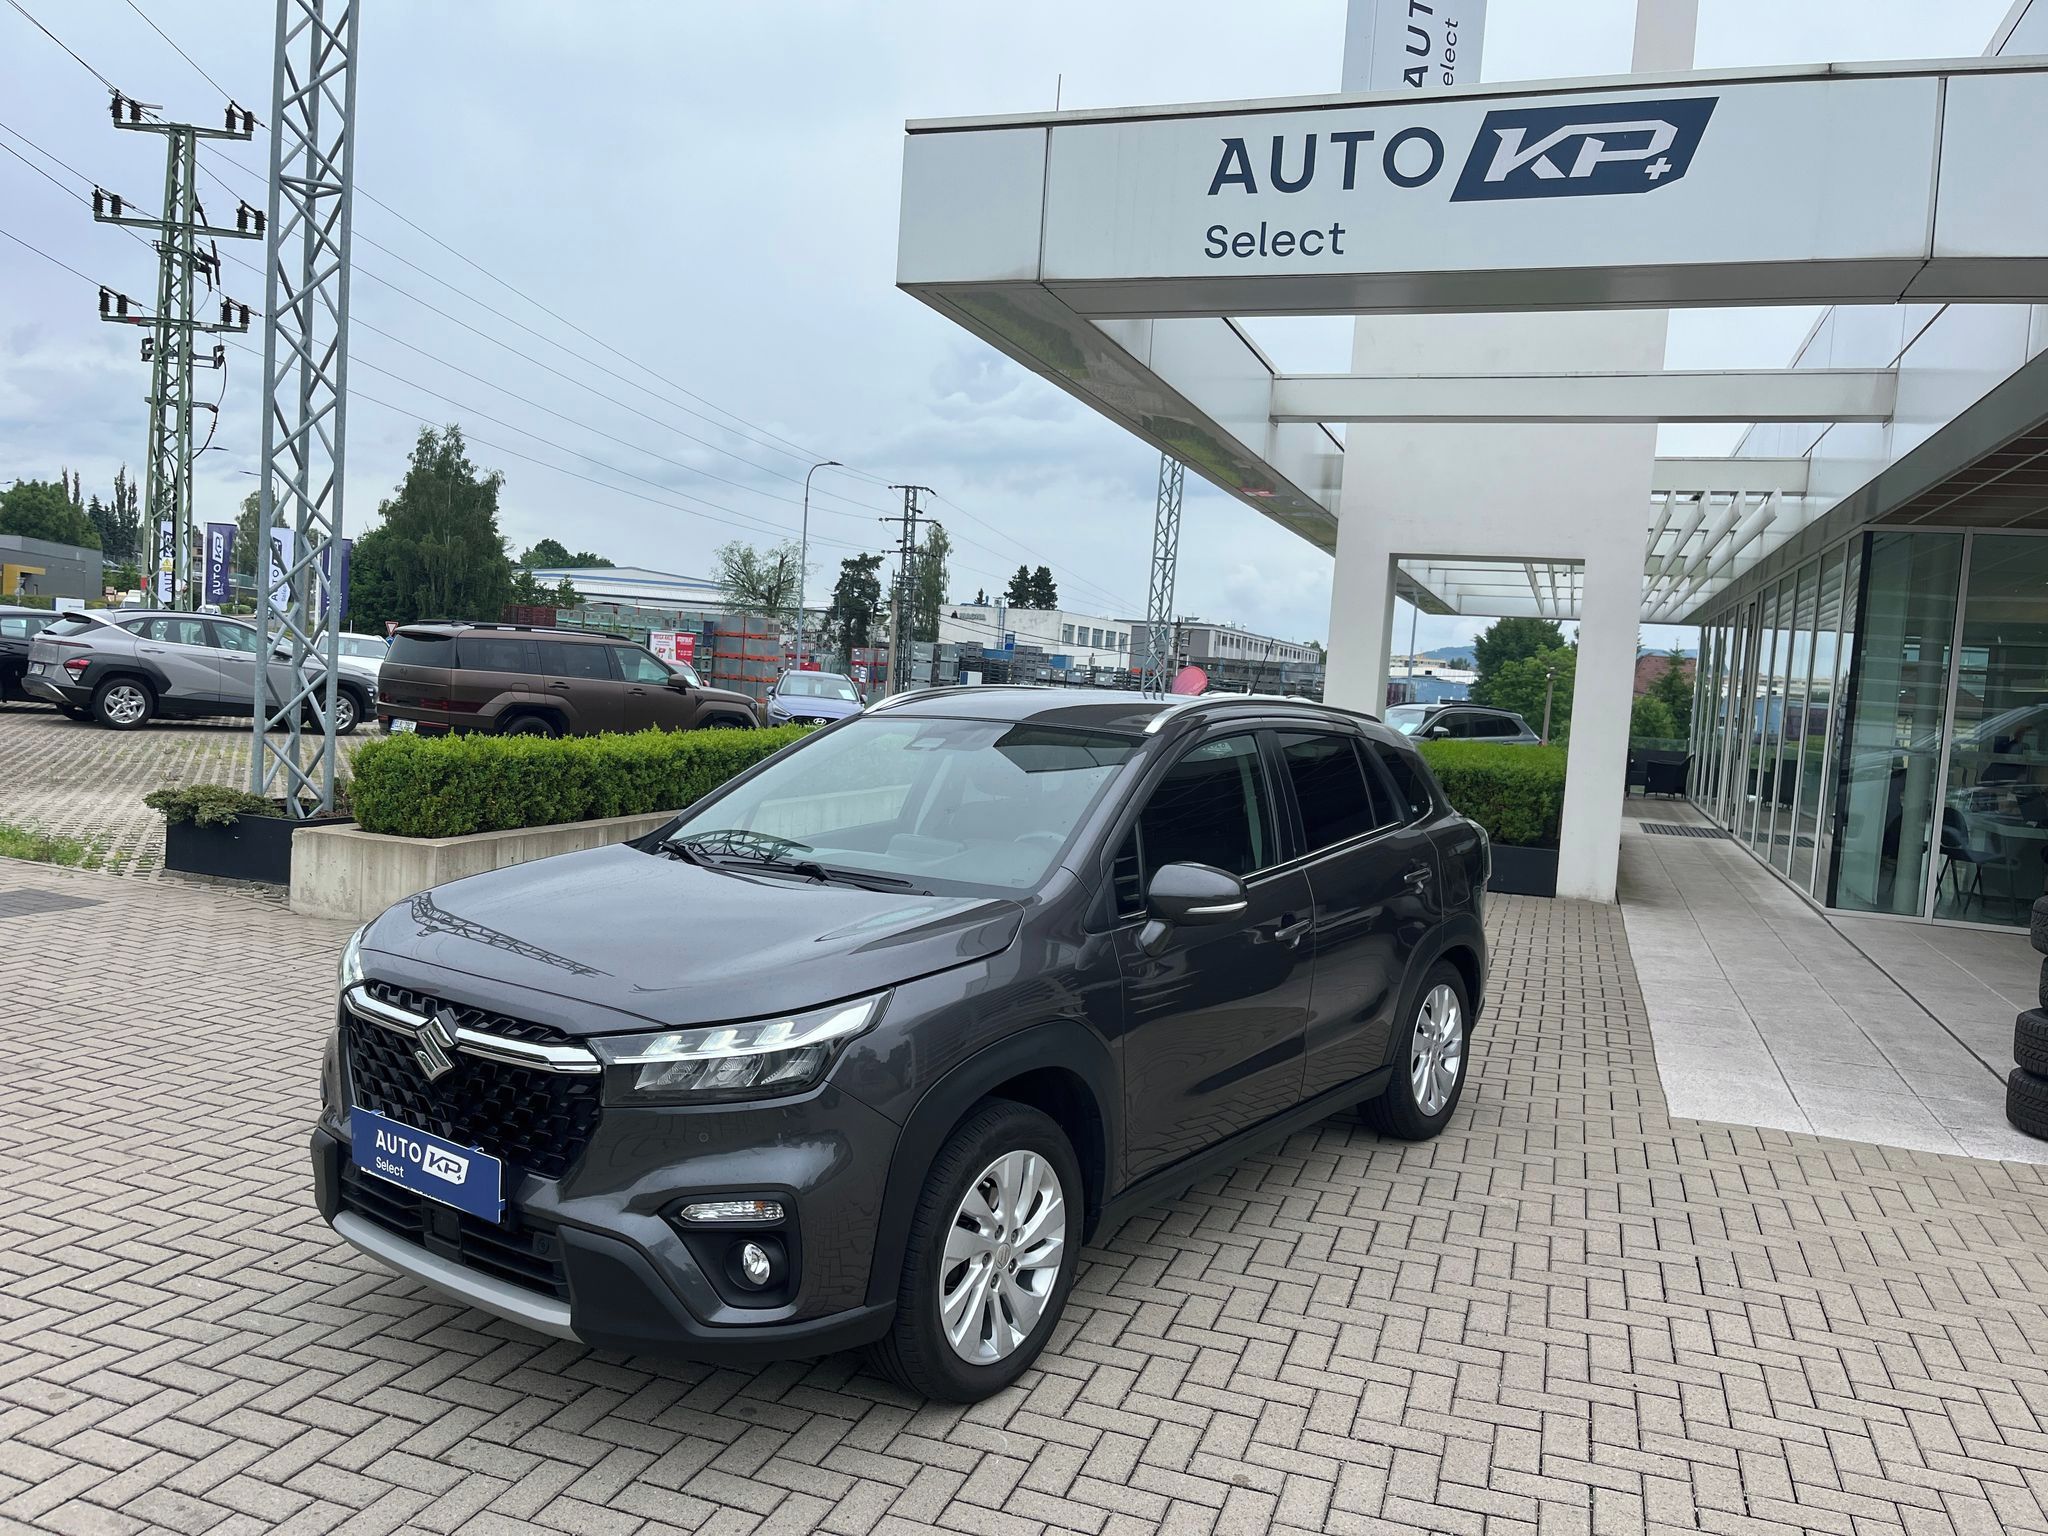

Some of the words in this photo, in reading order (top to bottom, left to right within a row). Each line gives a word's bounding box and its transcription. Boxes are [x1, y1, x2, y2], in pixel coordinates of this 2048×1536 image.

[1403, 0, 1434, 88] AUT
[1440, 17, 1459, 86] elect
[1206, 126, 1445, 197] AUTO
[1203, 221, 1346, 259] Select
[212, 563, 222, 597] AUTO
[271, 569, 279, 601] ATO
[375, 1129, 422, 1163] AUTO
[375, 1156, 405, 1179] Select
